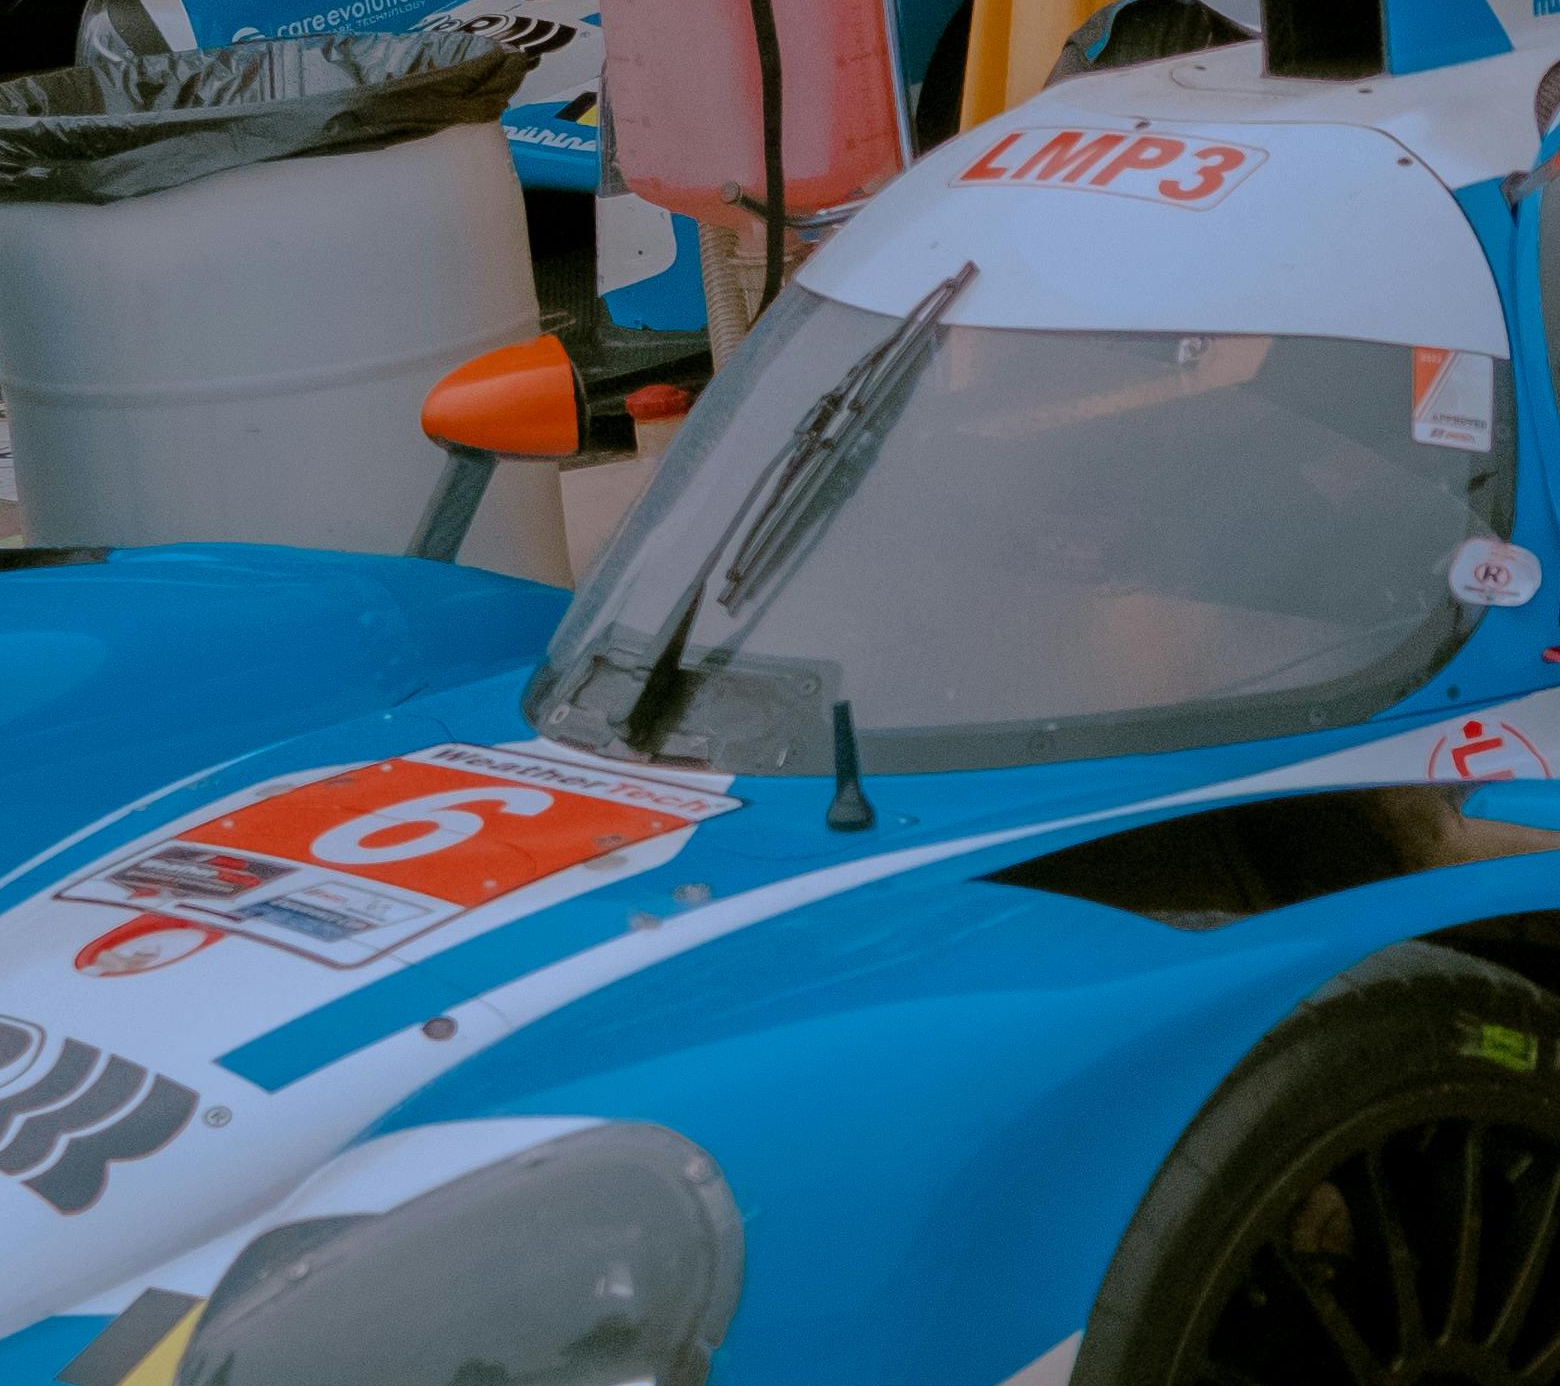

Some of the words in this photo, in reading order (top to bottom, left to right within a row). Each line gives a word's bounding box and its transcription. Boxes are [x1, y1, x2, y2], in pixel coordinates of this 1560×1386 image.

[960, 132, 1244, 202] LMP3
[428, 747, 712, 814] WeatherTech
[309, 785, 555, 866] 6
